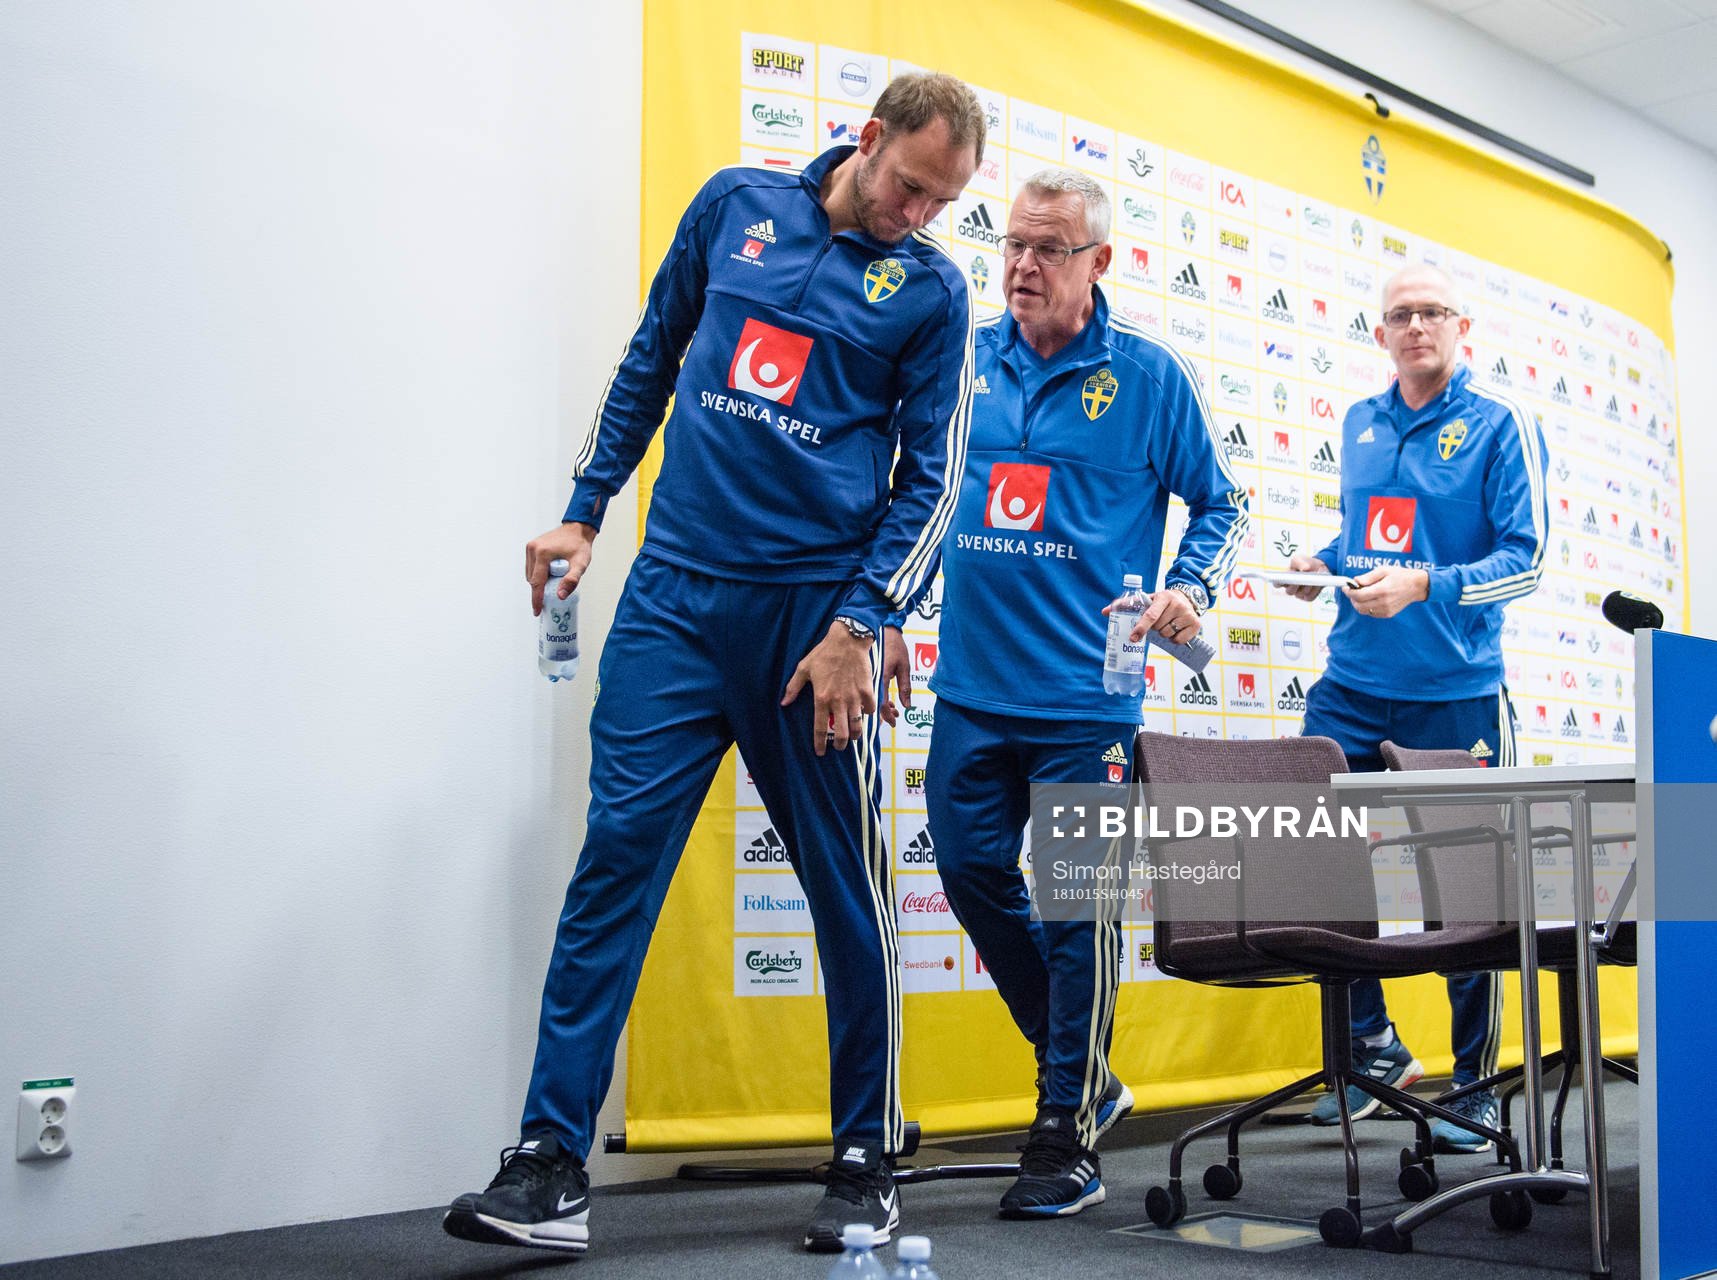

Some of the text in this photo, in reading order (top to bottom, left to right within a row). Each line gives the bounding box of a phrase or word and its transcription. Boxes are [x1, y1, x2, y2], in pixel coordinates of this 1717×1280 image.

[752, 49, 804, 73] SPORT
[752, 104, 803, 128] Carlsberg
[1016, 117, 1057, 142] Folksam
[1136, 149, 1146, 162] SJ
[1220, 181, 1247, 208] ICA
[744, 227, 776, 244] adidas
[958, 224, 1000, 244] adidas
[1170, 283, 1206, 301] adidas
[1263, 307, 1295, 324] adidas
[1171, 319, 1206, 344] Fabege
[1311, 397, 1335, 421] ICA
[701, 391, 822, 445] SVENSKA SPEL
[1226, 444, 1254, 459] didas
[1268, 487, 1299, 510] Fabege
[1281, 530, 1290, 543] SJ
[957, 533, 1078, 560] SVENSKA SPEL
[1228, 577, 1256, 601] ICA
[546, 632, 577, 643] bonaqua
[1228, 627, 1261, 647] SPORT
[1180, 692, 1218, 706] adidas
[1278, 699, 1305, 711] adida
[1101, 754, 1128, 765] adidas
[744, 846, 790, 862] adid
[903, 848, 935, 863] adid
[743, 895, 805, 911] Folksam
[746, 951, 802, 975] Carlsberg
[904, 960, 942, 969] Swedbank
[845, 1147, 865, 1157] NIKE
